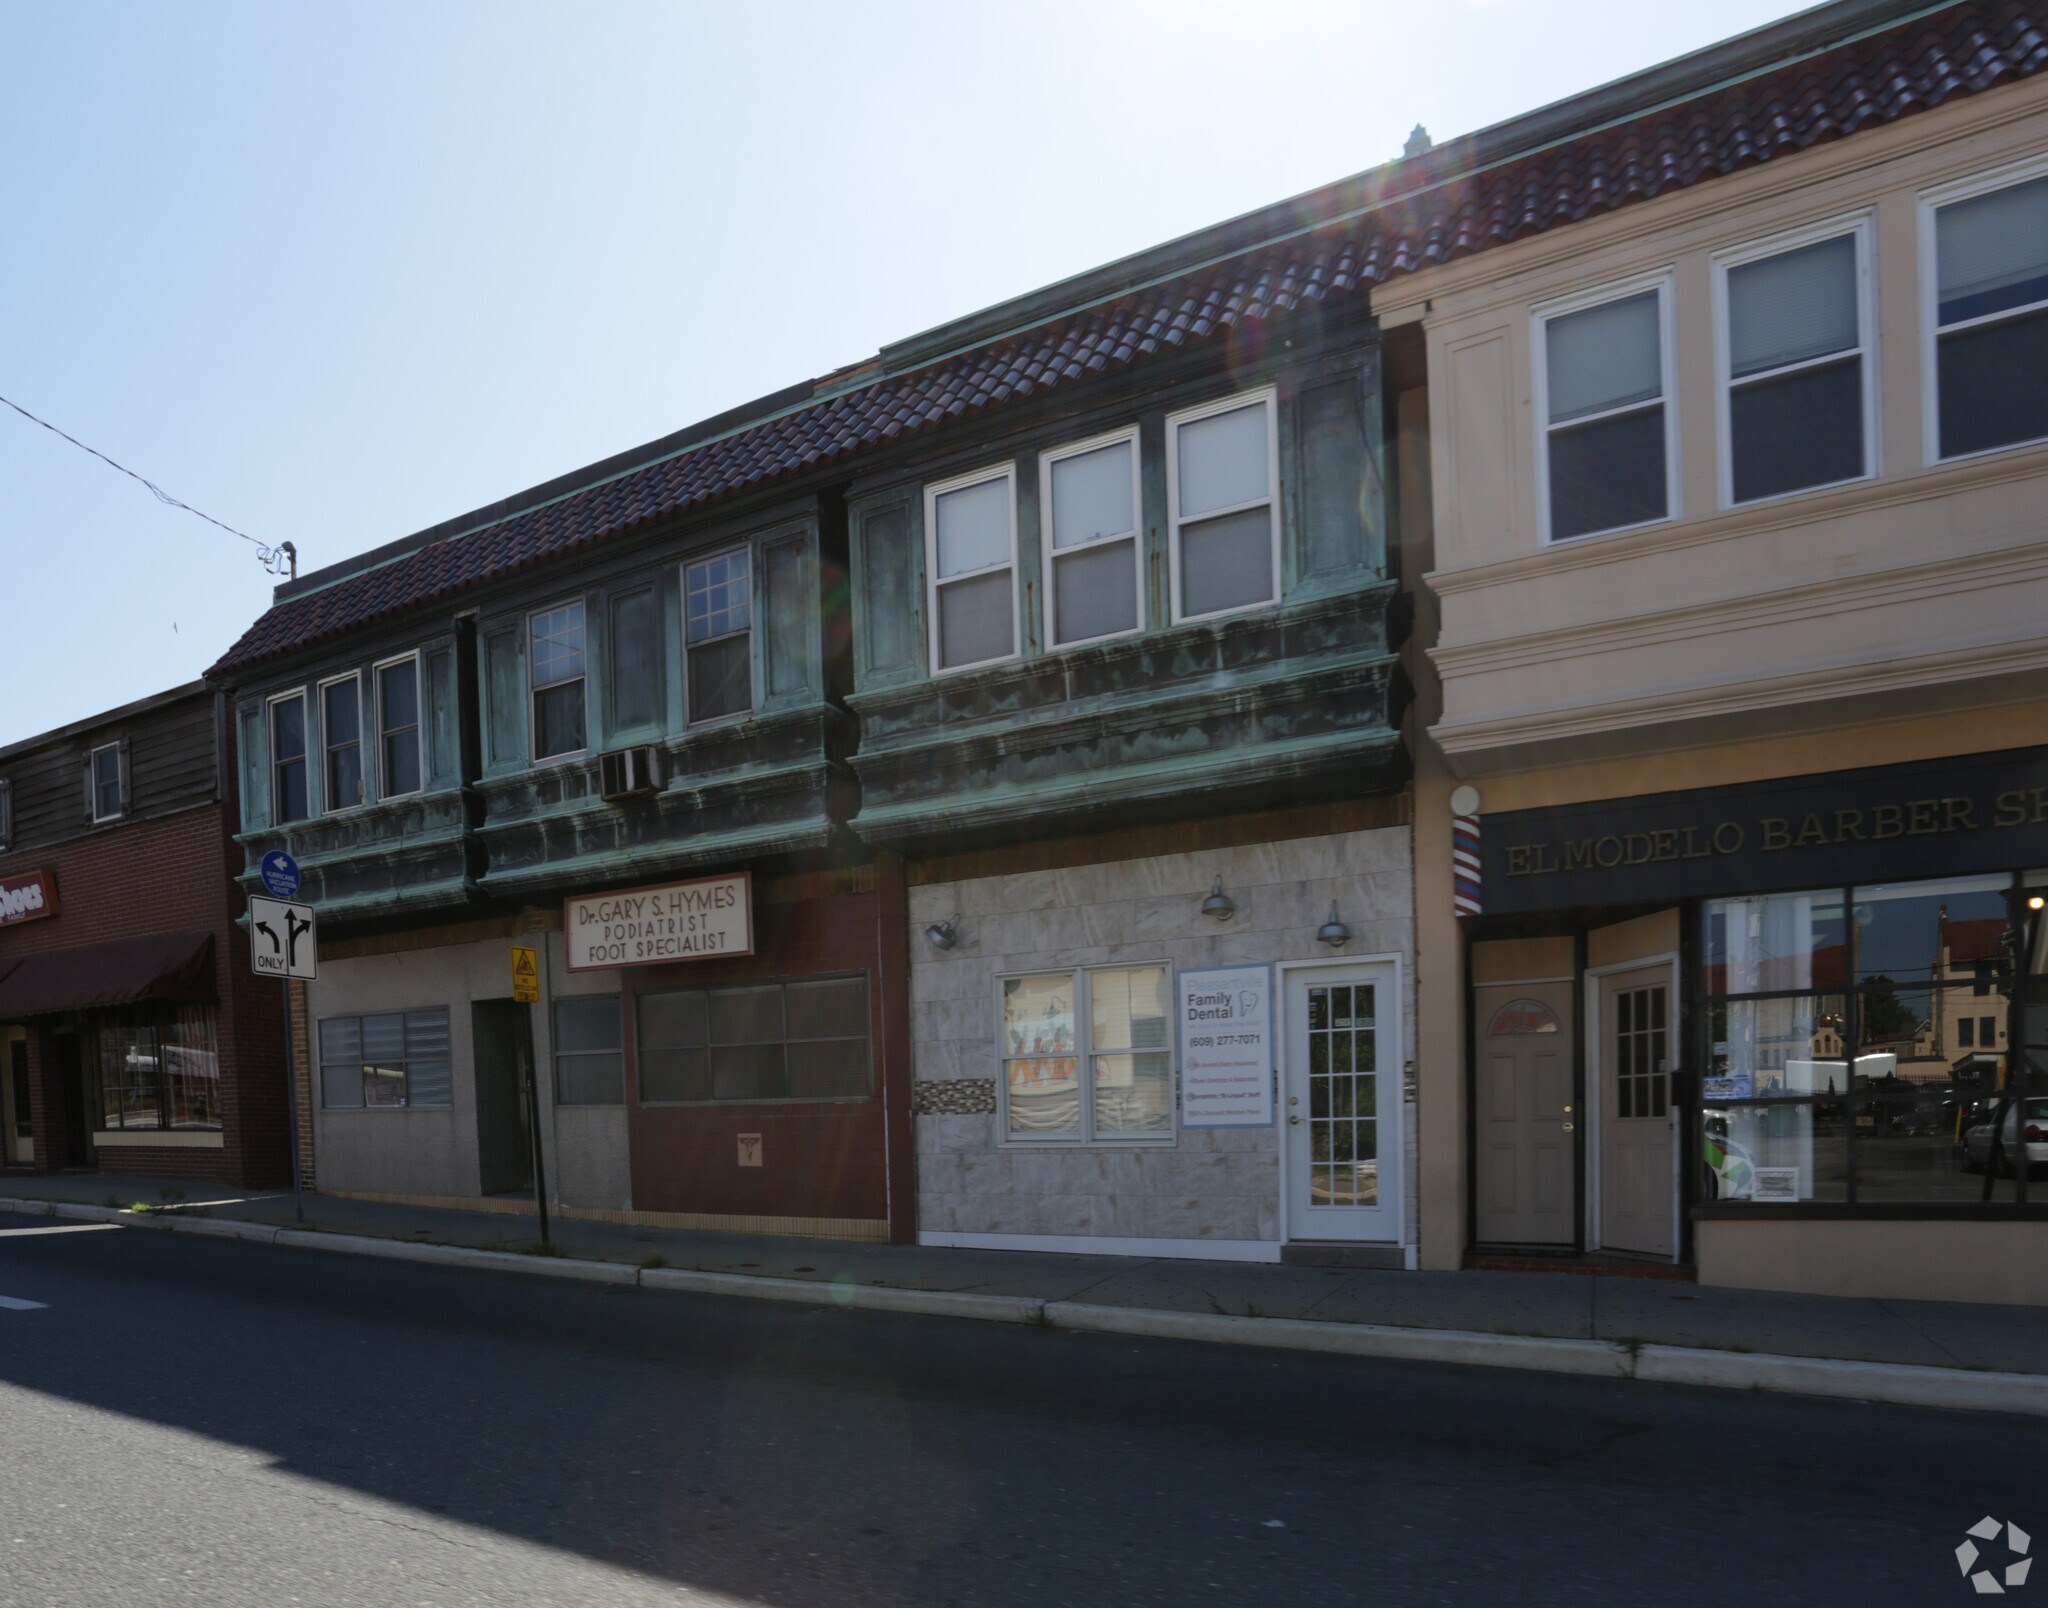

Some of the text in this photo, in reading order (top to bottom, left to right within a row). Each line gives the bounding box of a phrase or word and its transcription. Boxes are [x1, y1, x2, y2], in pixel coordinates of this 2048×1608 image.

[1564, 821, 1744, 871] MODELO
[1760, 796, 1980, 851] BARBER
[266, 871, 297, 882] HURRICANE
[272, 886, 290, 895] ROUTE
[652, 895, 664, 916] S.
[670, 885, 735, 914] HYMES
[605, 913, 708, 942] PODIATRIST
[589, 931, 726, 962] FOOT SPECIALIST
[258, 955, 284, 970] ONLY
[1187, 992, 1232, 1006] Family
[1188, 1006, 1233, 1020] Dental
[1189, 1034, 1261, 1048] (609) 277-7071
